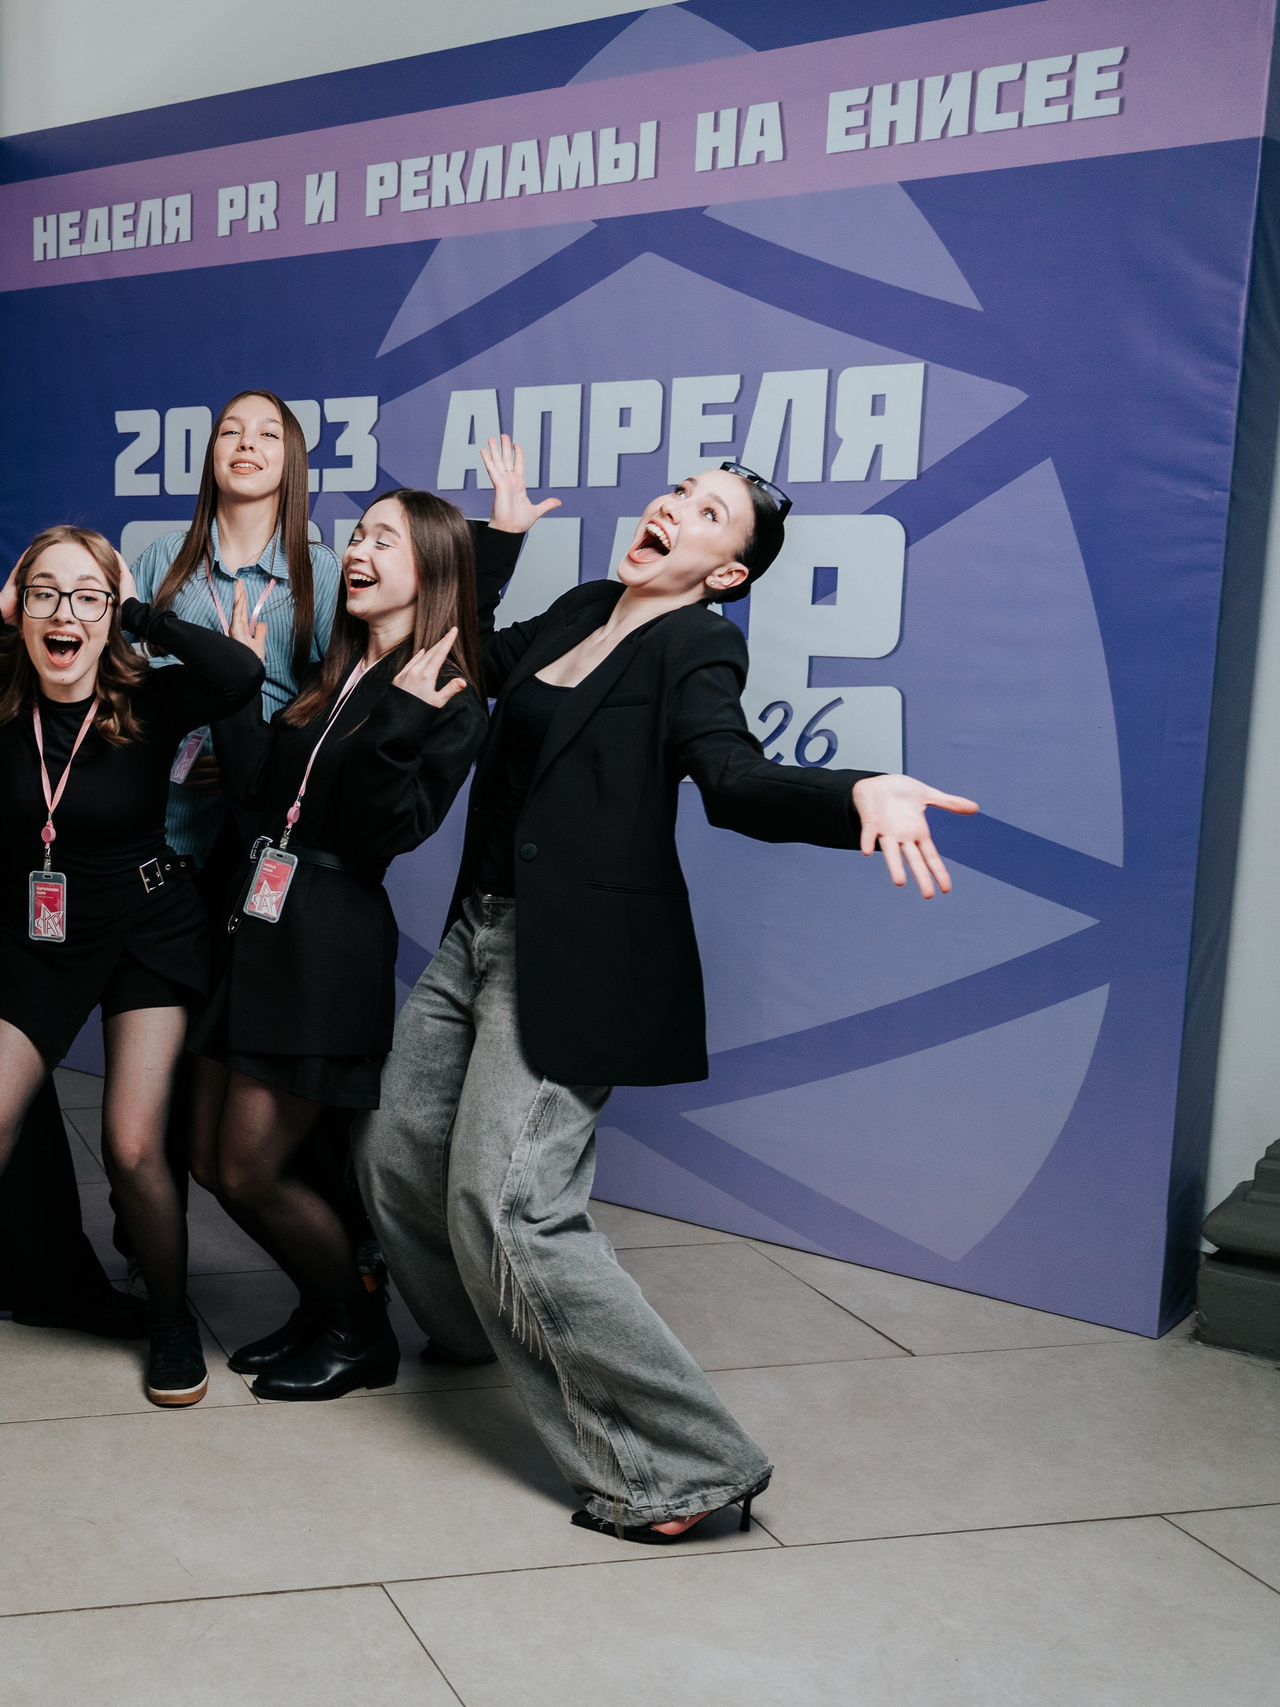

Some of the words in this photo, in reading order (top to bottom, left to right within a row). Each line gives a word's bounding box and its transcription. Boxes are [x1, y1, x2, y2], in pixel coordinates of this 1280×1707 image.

[33, 193, 192, 262] НЕДЕЛЯ
[217, 180, 277, 237] PR
[305, 171, 337, 225] И
[365, 120, 659, 217] РЕКЛАМЫ
[695, 101, 785, 172] НА
[826, 46, 1126, 154] ЕНИСЕЕ
[437, 362, 926, 490] АПРЕЛЯ
